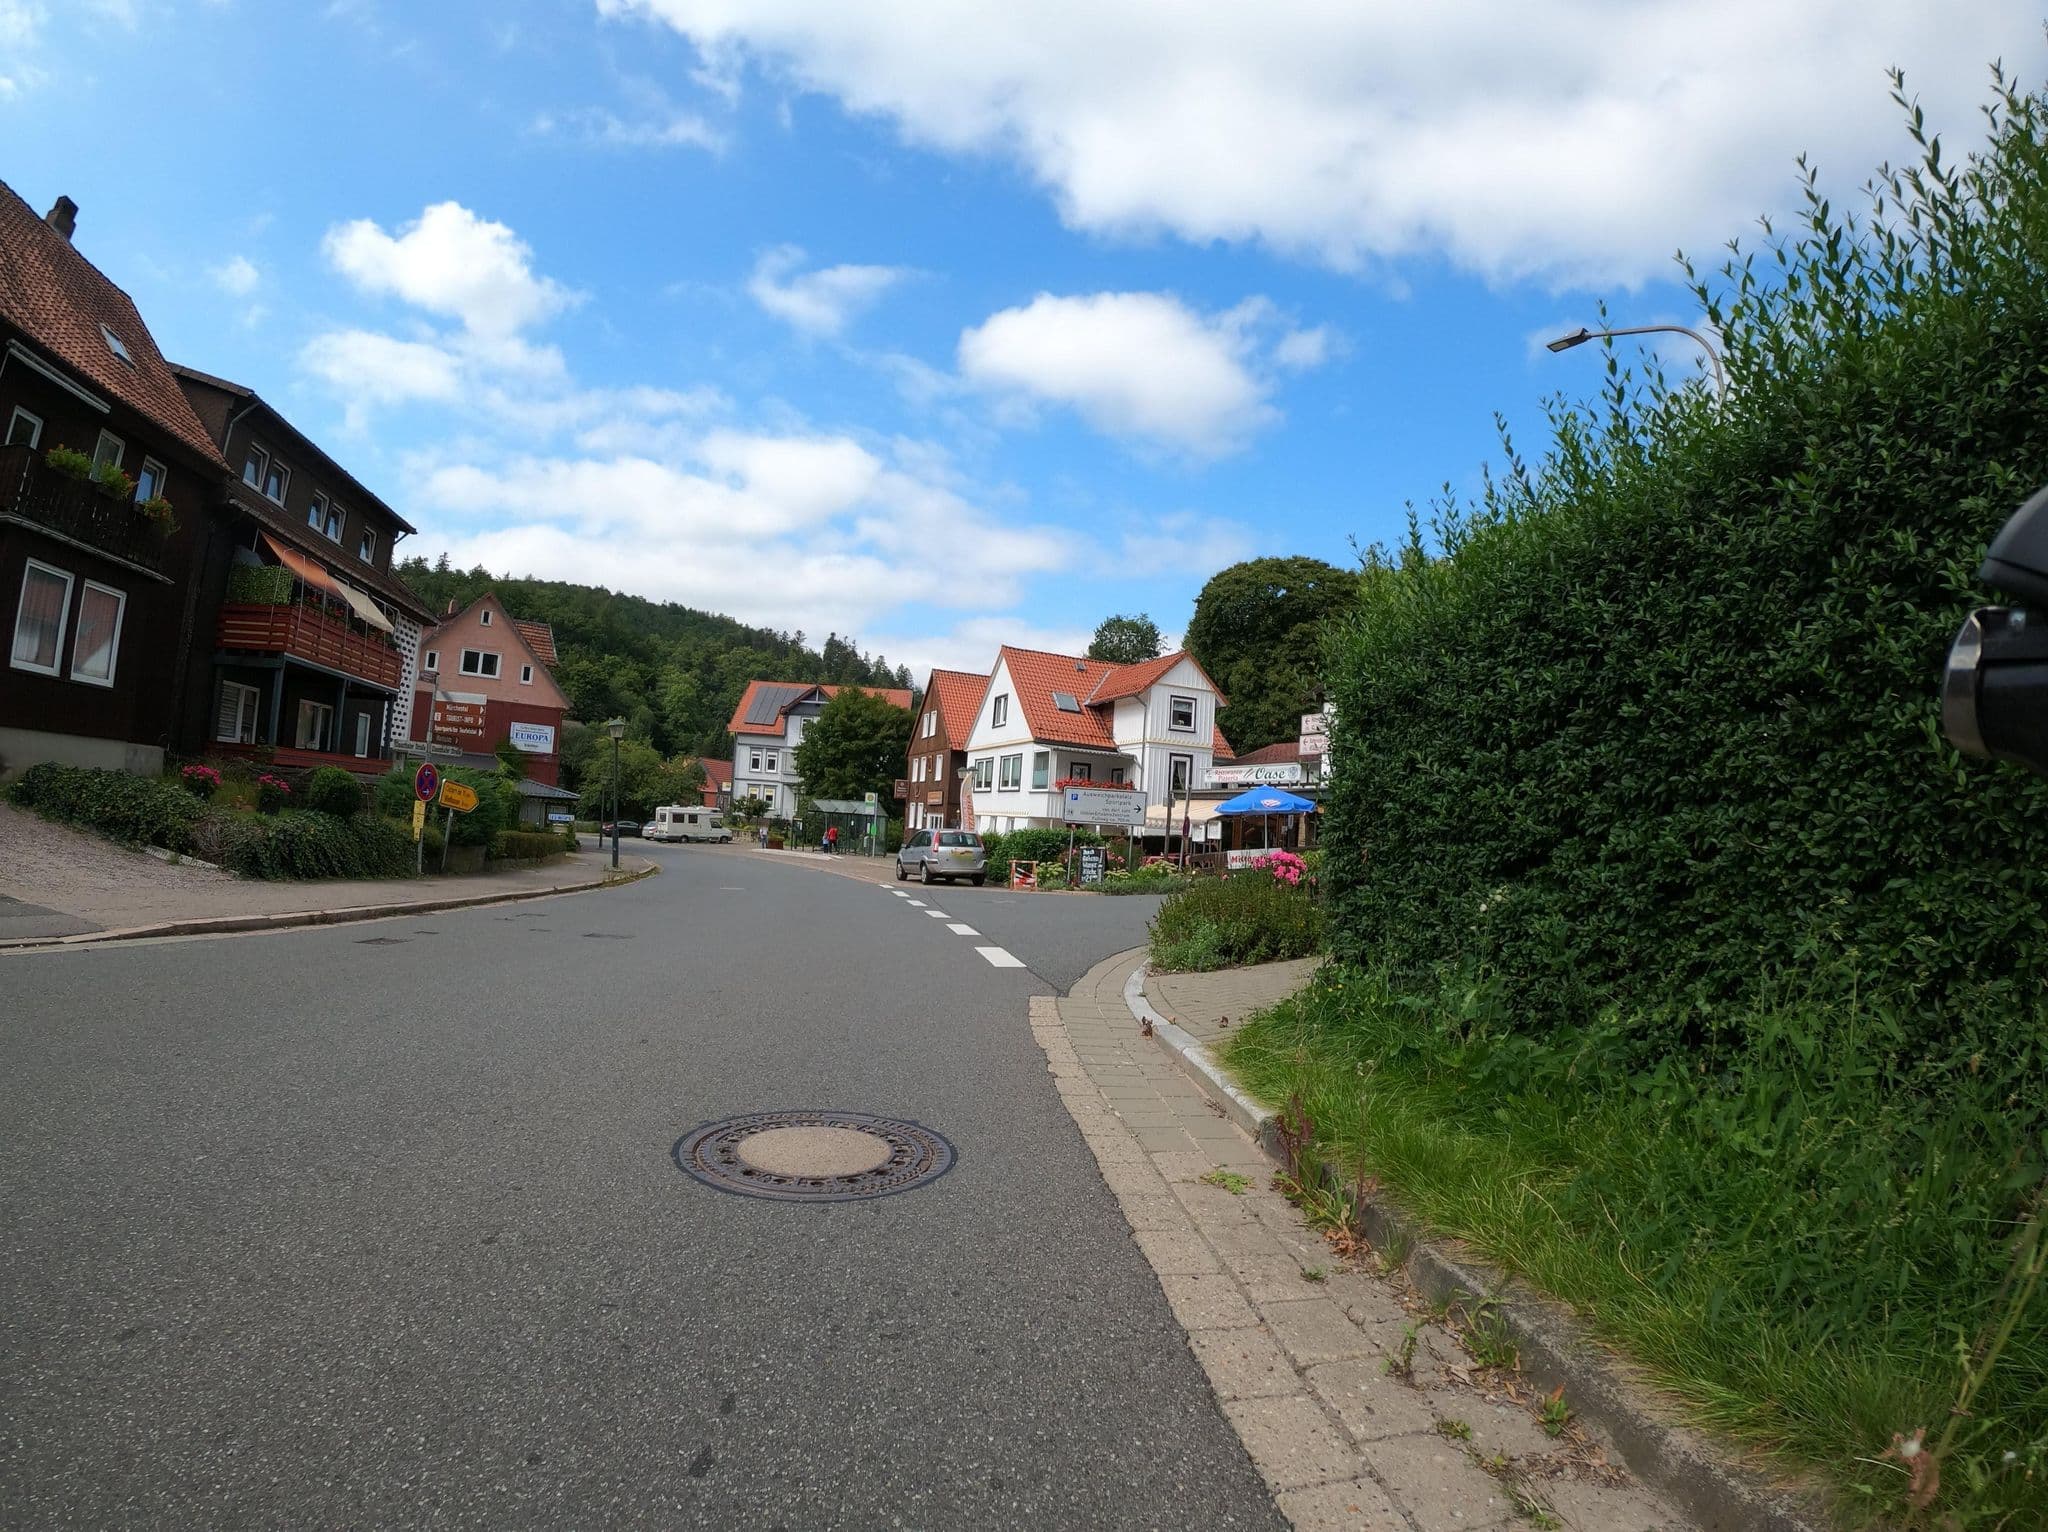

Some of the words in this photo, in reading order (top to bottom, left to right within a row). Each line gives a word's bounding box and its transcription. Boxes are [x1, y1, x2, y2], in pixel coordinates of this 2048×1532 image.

[515, 732, 549, 742] EUROPA
[1255, 767, 1286, 780] Oase
[1083, 791, 1132, 800] Ausweichparkplatz
